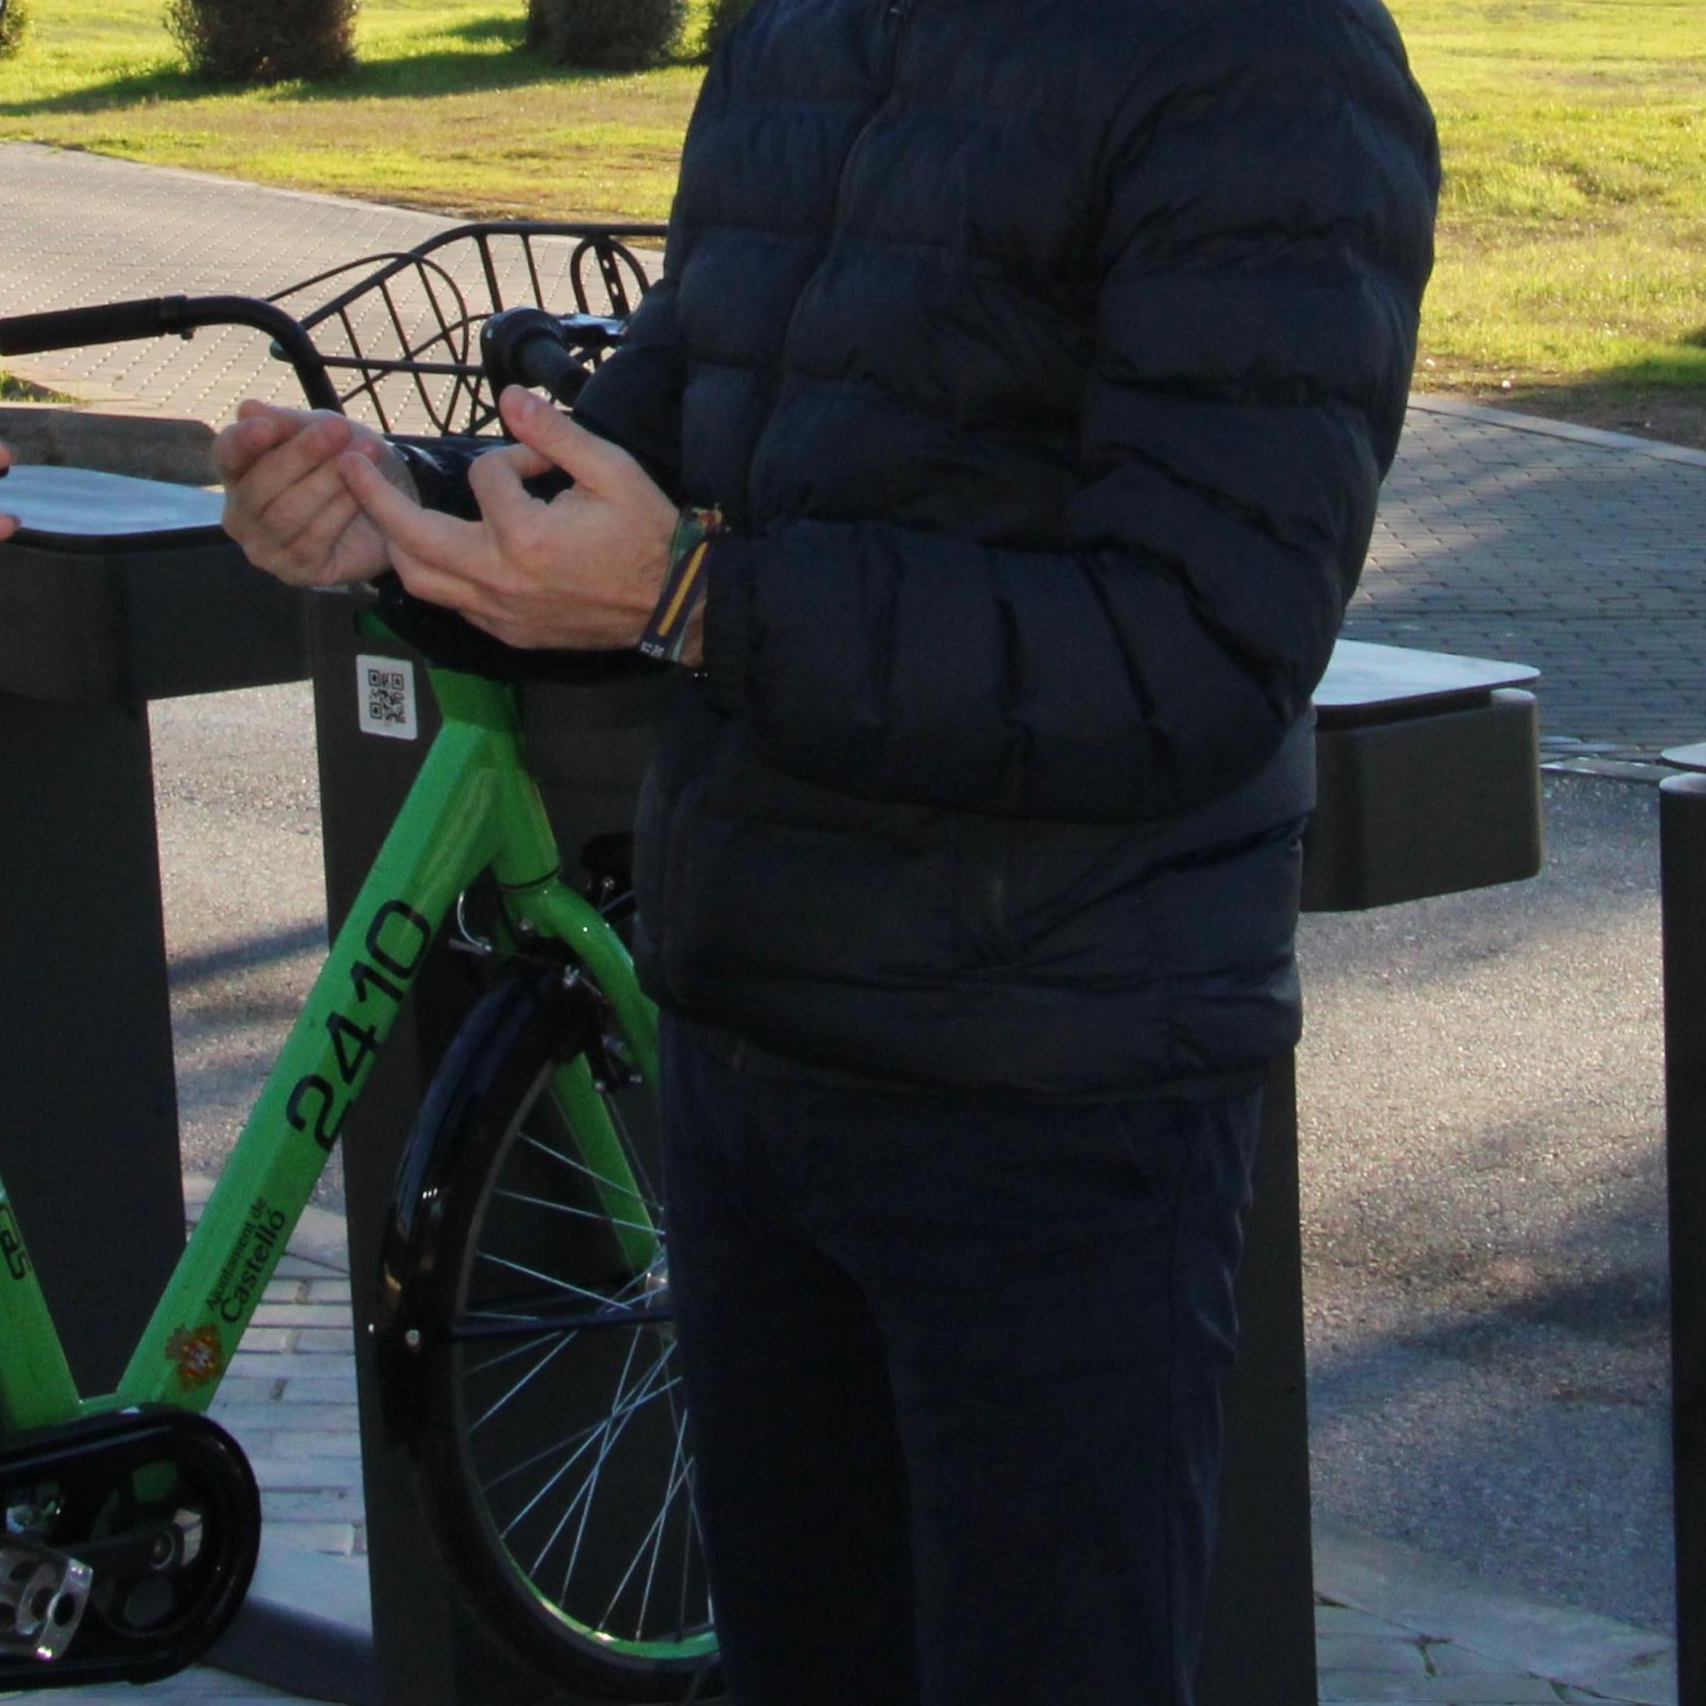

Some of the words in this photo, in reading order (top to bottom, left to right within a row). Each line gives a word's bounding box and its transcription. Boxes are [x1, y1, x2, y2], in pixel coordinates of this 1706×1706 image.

[286, 899, 431, 1153] 2410
[206, 1220, 255, 1312] Ajuntament
[250, 1197, 267, 1220] de
[220, 1207, 286, 1323] Castelló
